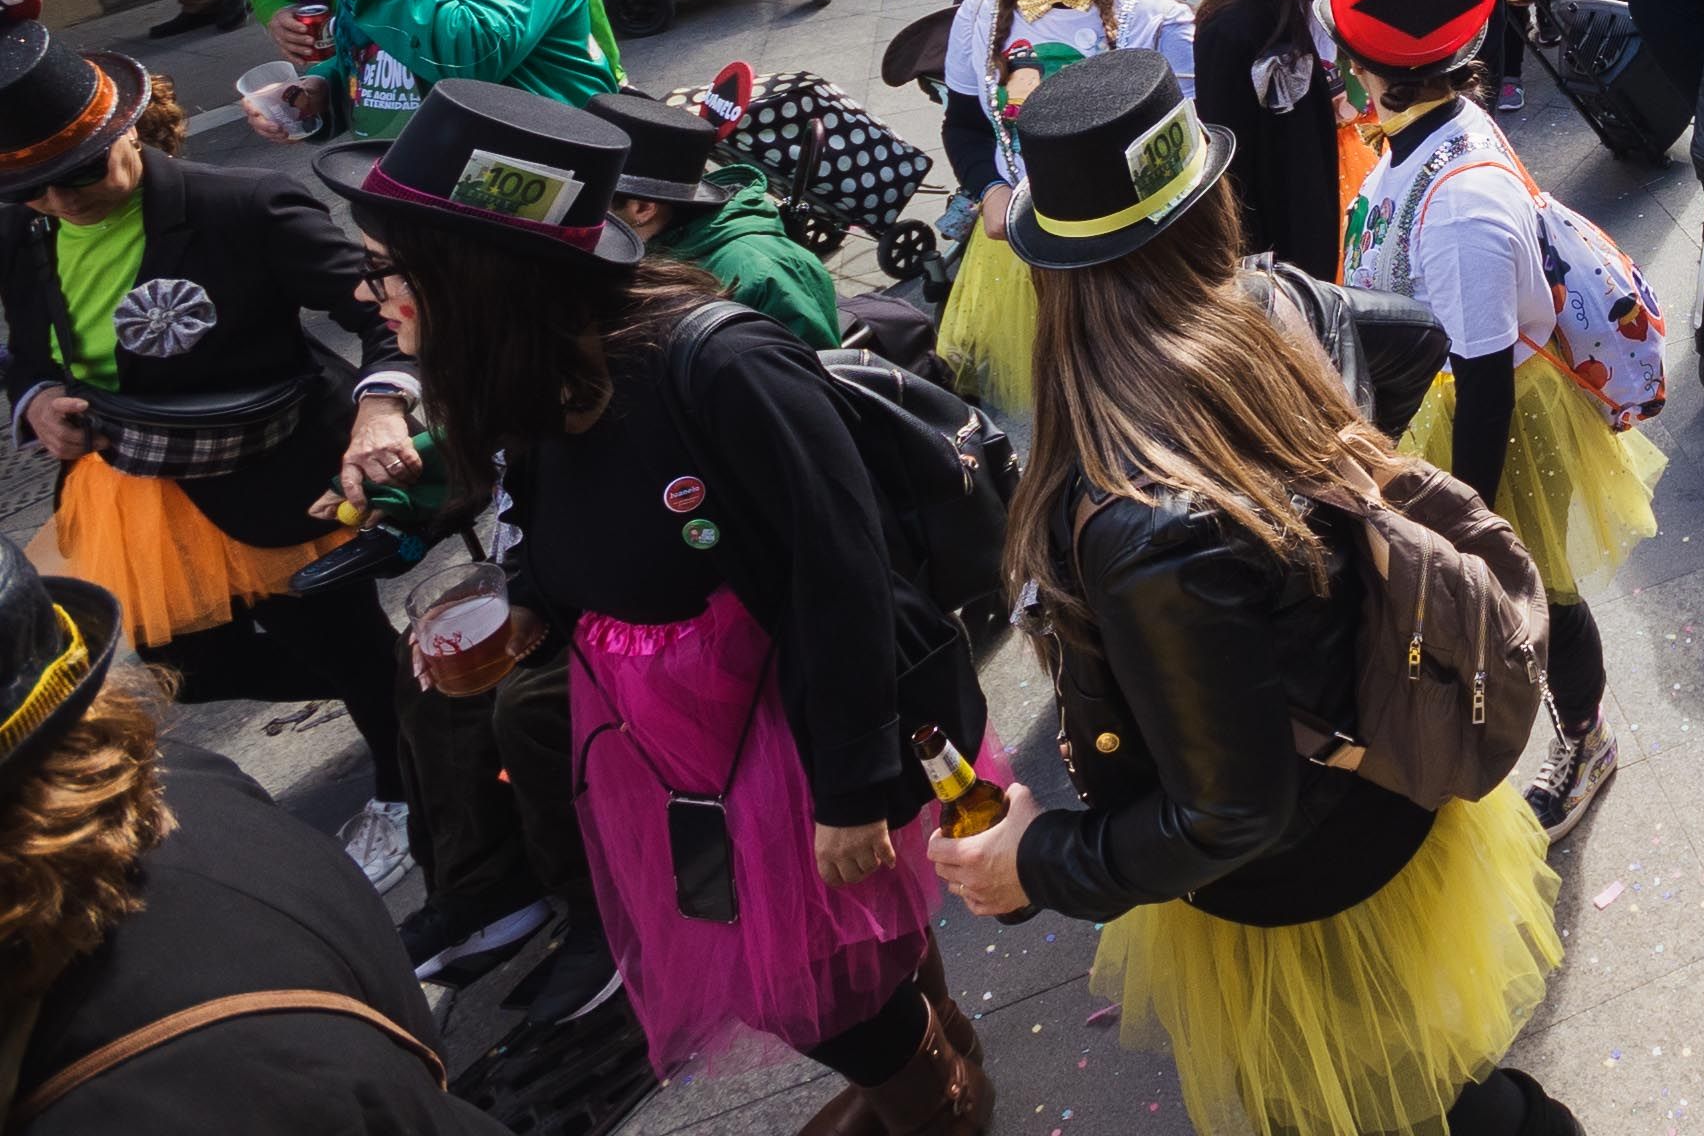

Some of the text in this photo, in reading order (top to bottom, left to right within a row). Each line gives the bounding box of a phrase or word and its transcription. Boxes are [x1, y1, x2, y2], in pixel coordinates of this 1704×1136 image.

[363, 63, 376, 86] DE
[361, 89, 373, 99] DE
[398, 92, 409, 102] A
[1143, 122, 1184, 166] 100
[488, 166, 546, 205] 100
